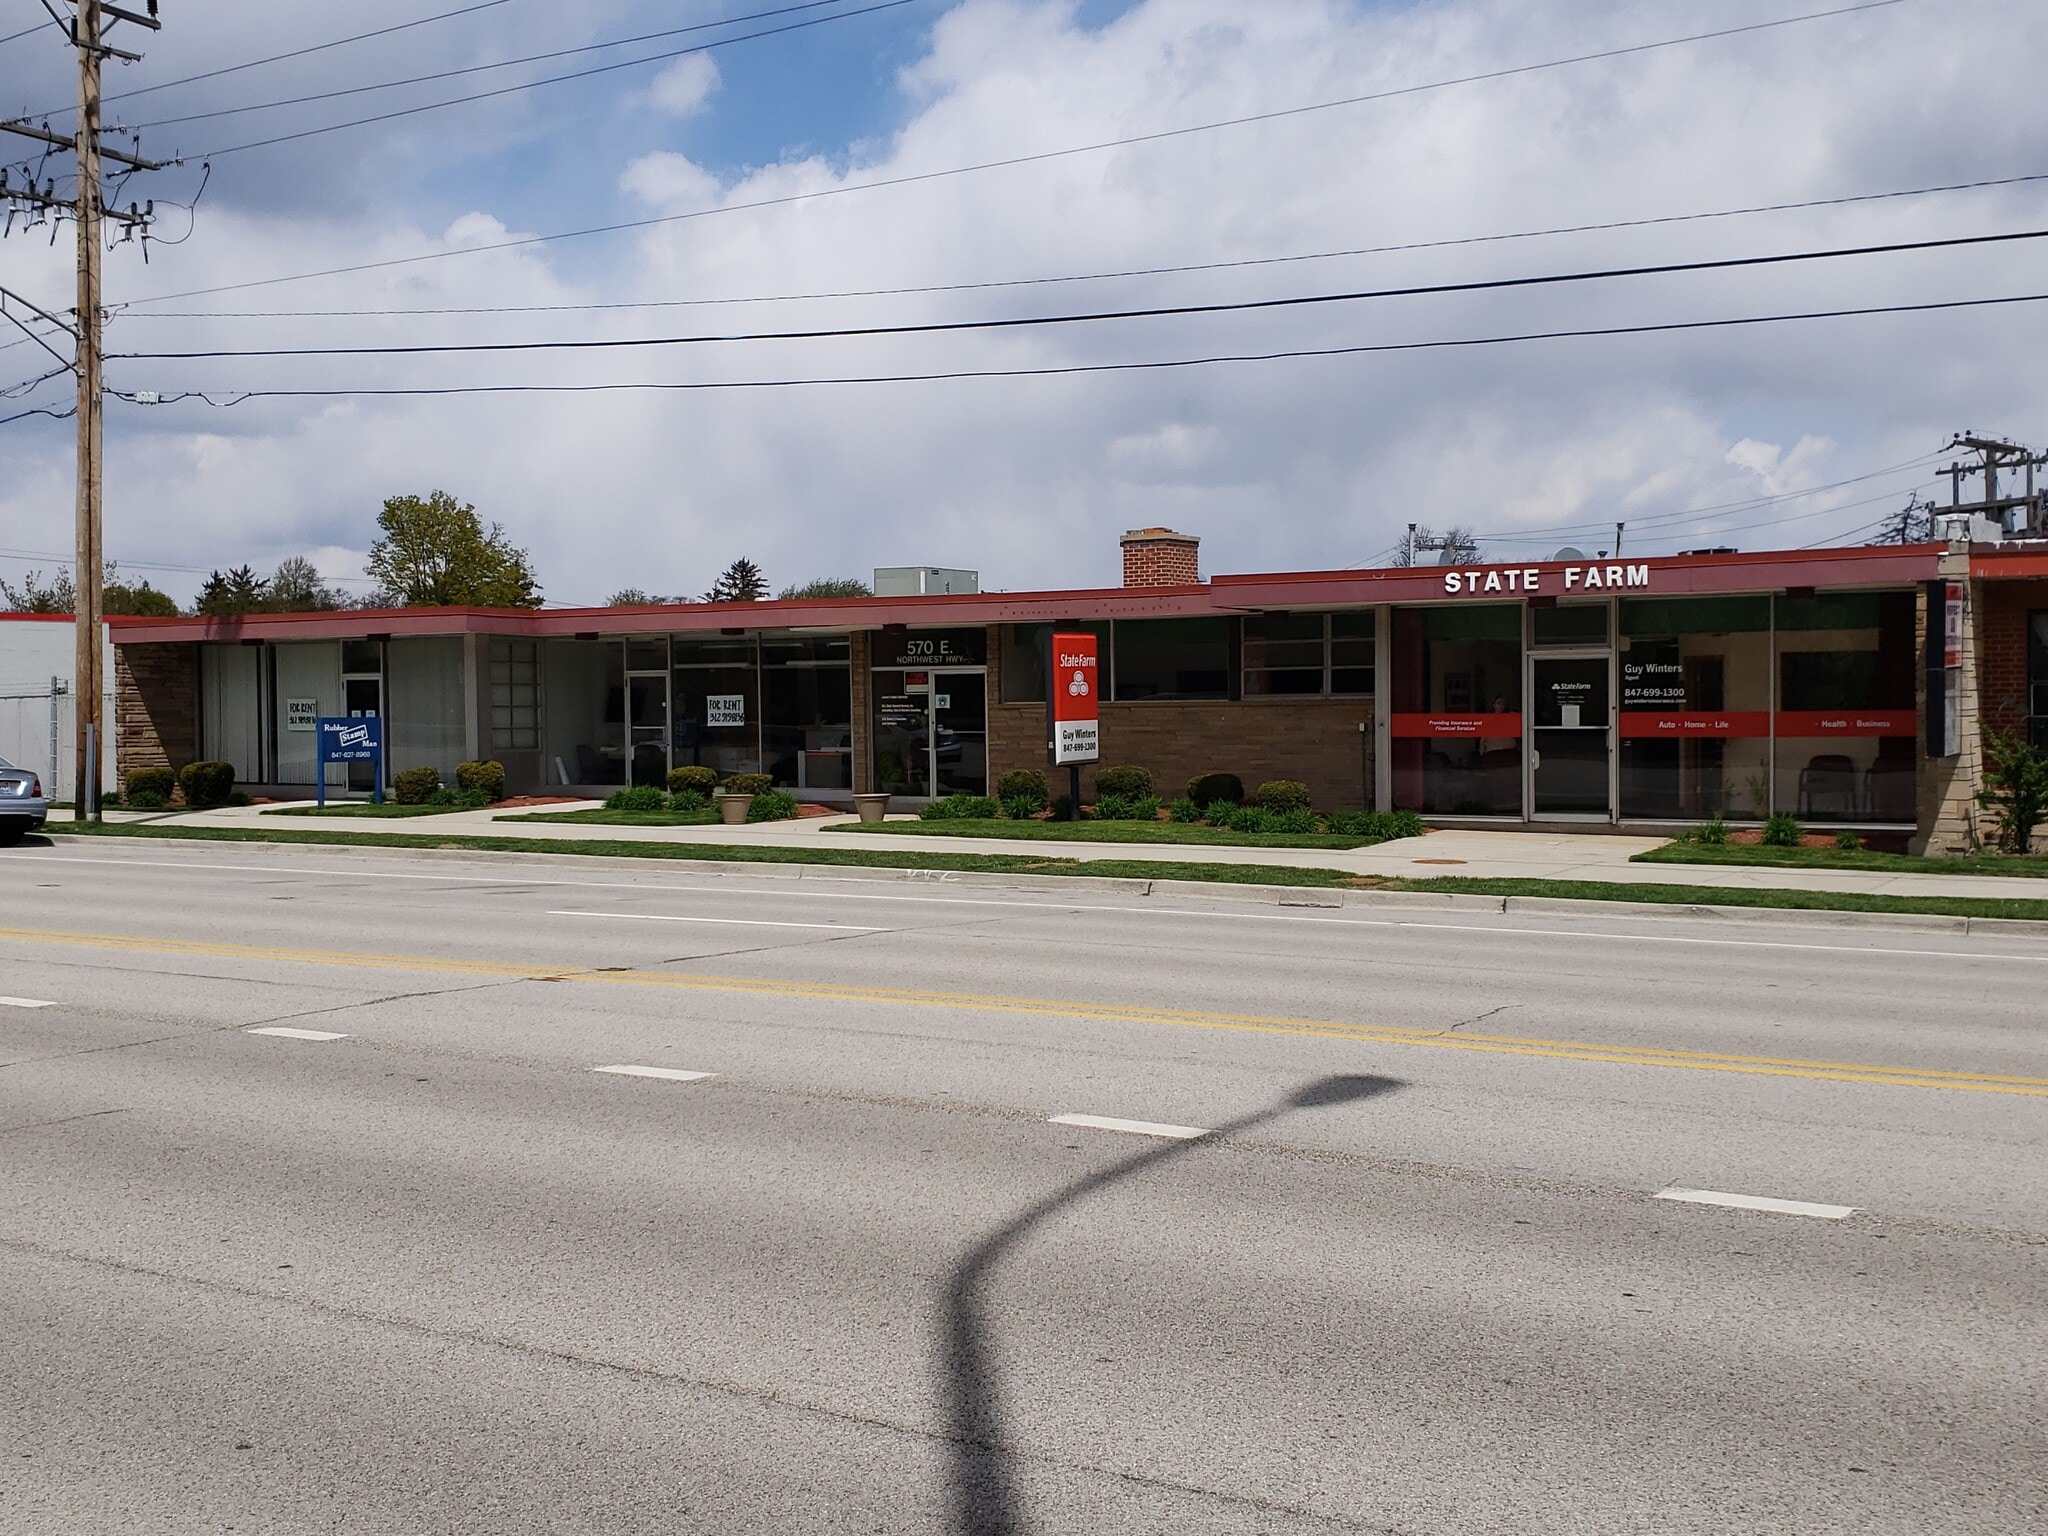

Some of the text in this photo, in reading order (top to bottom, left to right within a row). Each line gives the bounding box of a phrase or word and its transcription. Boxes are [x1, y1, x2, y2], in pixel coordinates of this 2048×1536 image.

[1445, 565, 1648, 593] STATE FARM
[907, 640, 953, 654] 570 E.
[896, 656, 943, 664] NORTHWEST
[1625, 663, 1683, 674] Guy Winters
[1625, 688, 1685, 696] 847-699-1300
[709, 700, 741, 711] FOR RENT
[1821, 720, 1847, 728] Health
[1856, 720, 1891, 728] Business
[342, 730, 365, 742] Stamp
[1063, 729, 1097, 741] Guy Winters
[1063, 742, 1097, 752] 847-699-1300
